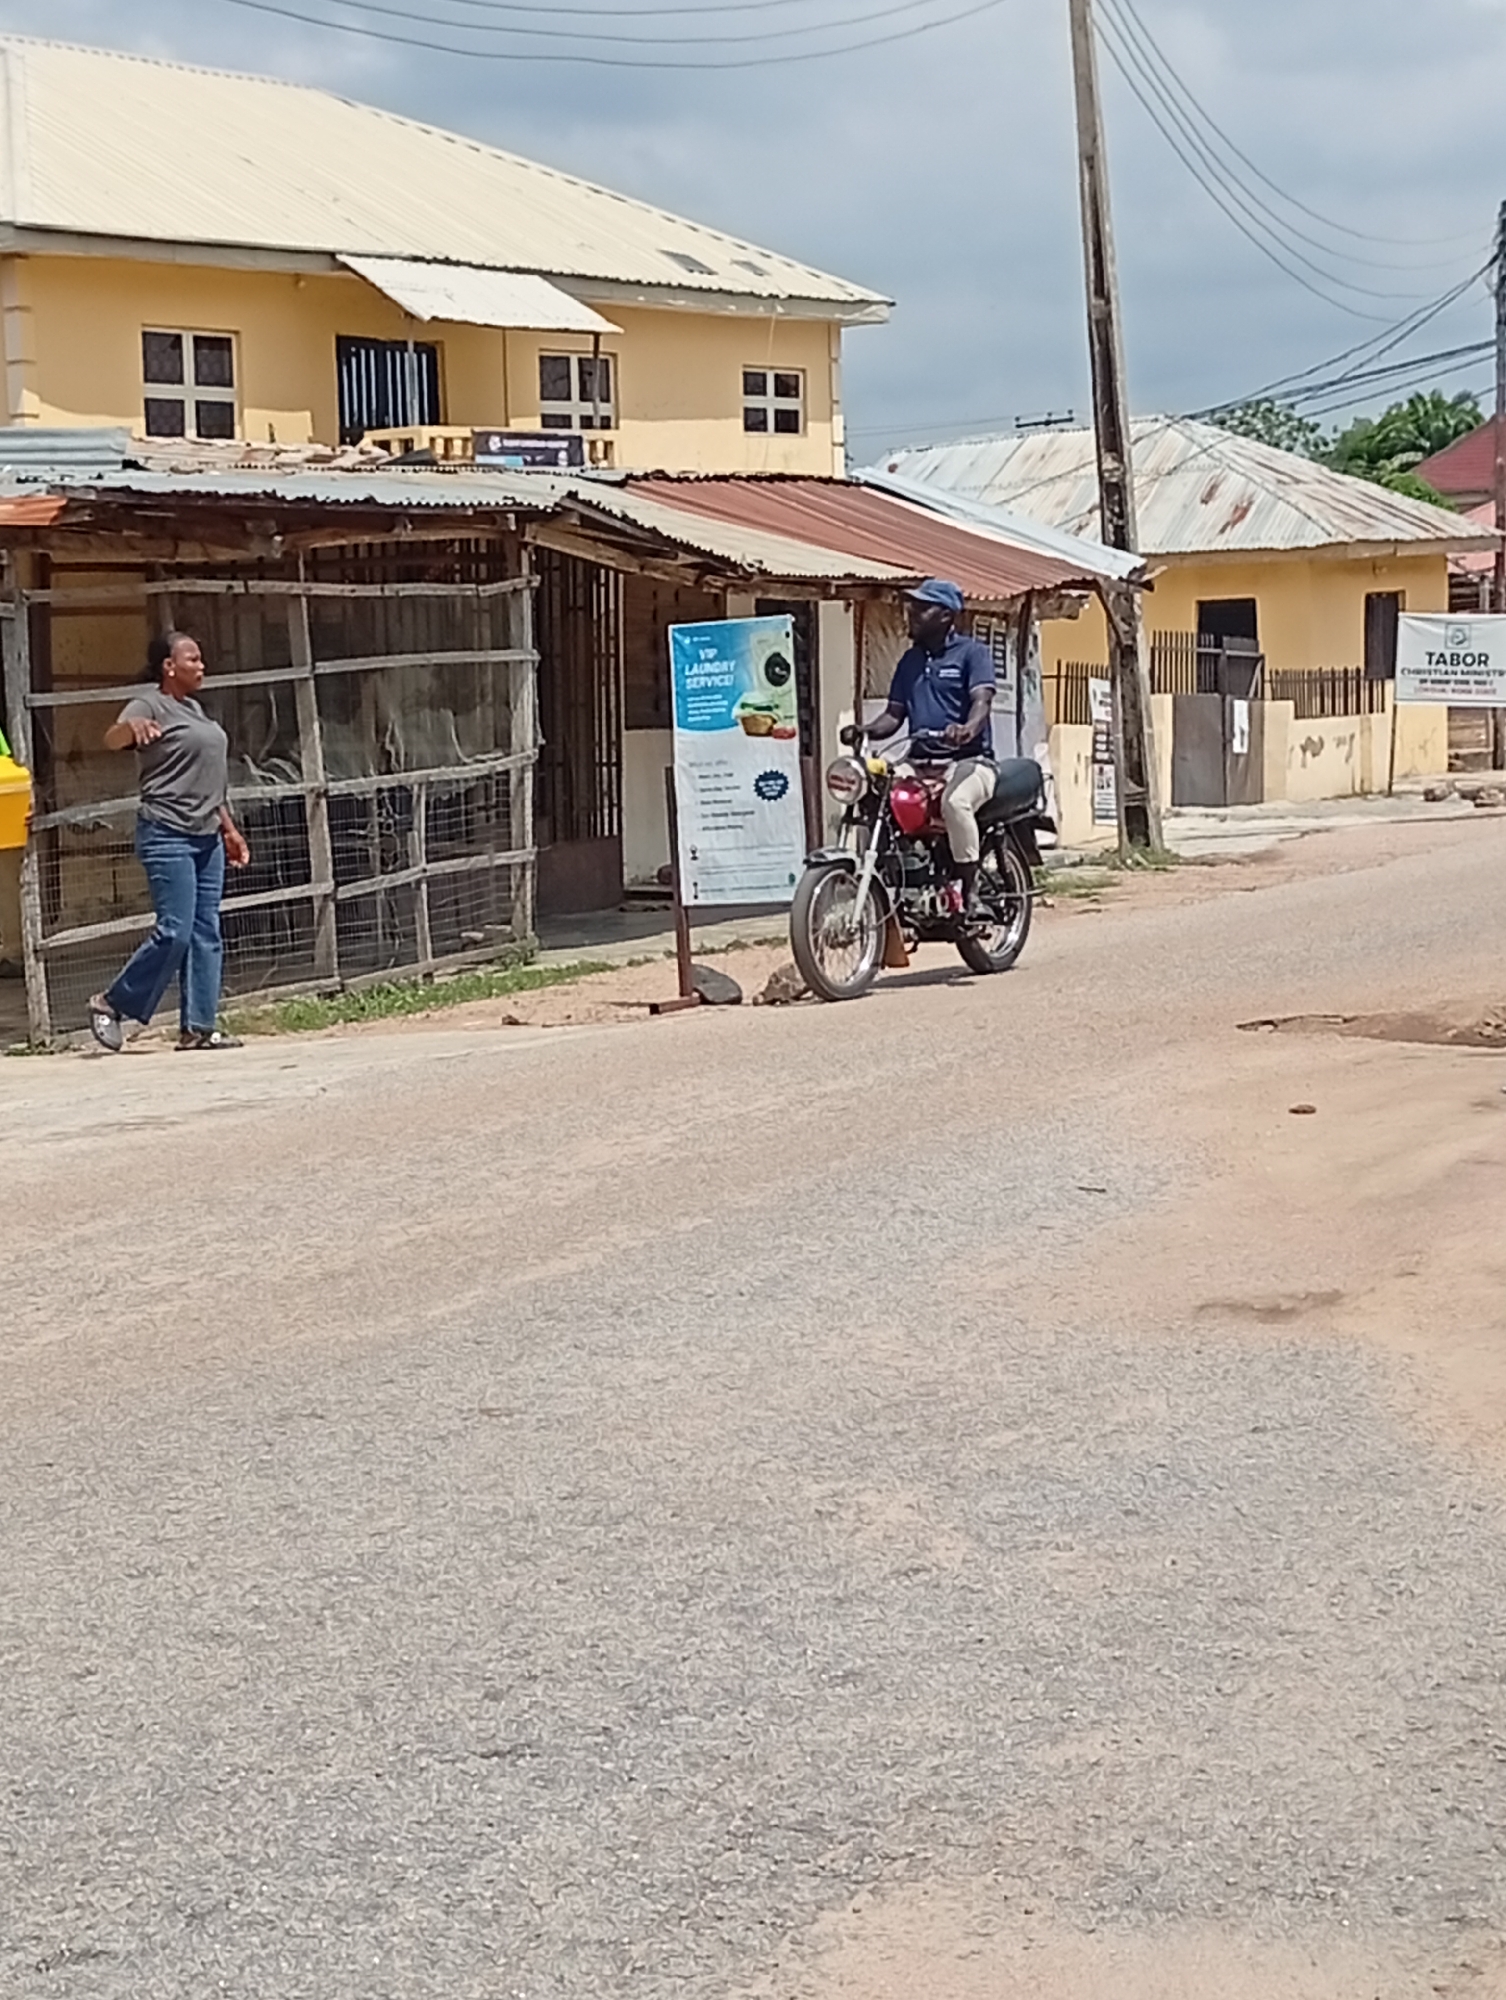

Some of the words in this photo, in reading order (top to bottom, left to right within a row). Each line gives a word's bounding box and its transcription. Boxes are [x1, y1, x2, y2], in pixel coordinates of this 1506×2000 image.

[1425, 651, 1490, 668] TABOR
[684, 660, 736, 676] LAUNDRY
[1400, 667, 1459, 677] CHRISTIAN
[1460, 668, 1506, 677] MINISTR
